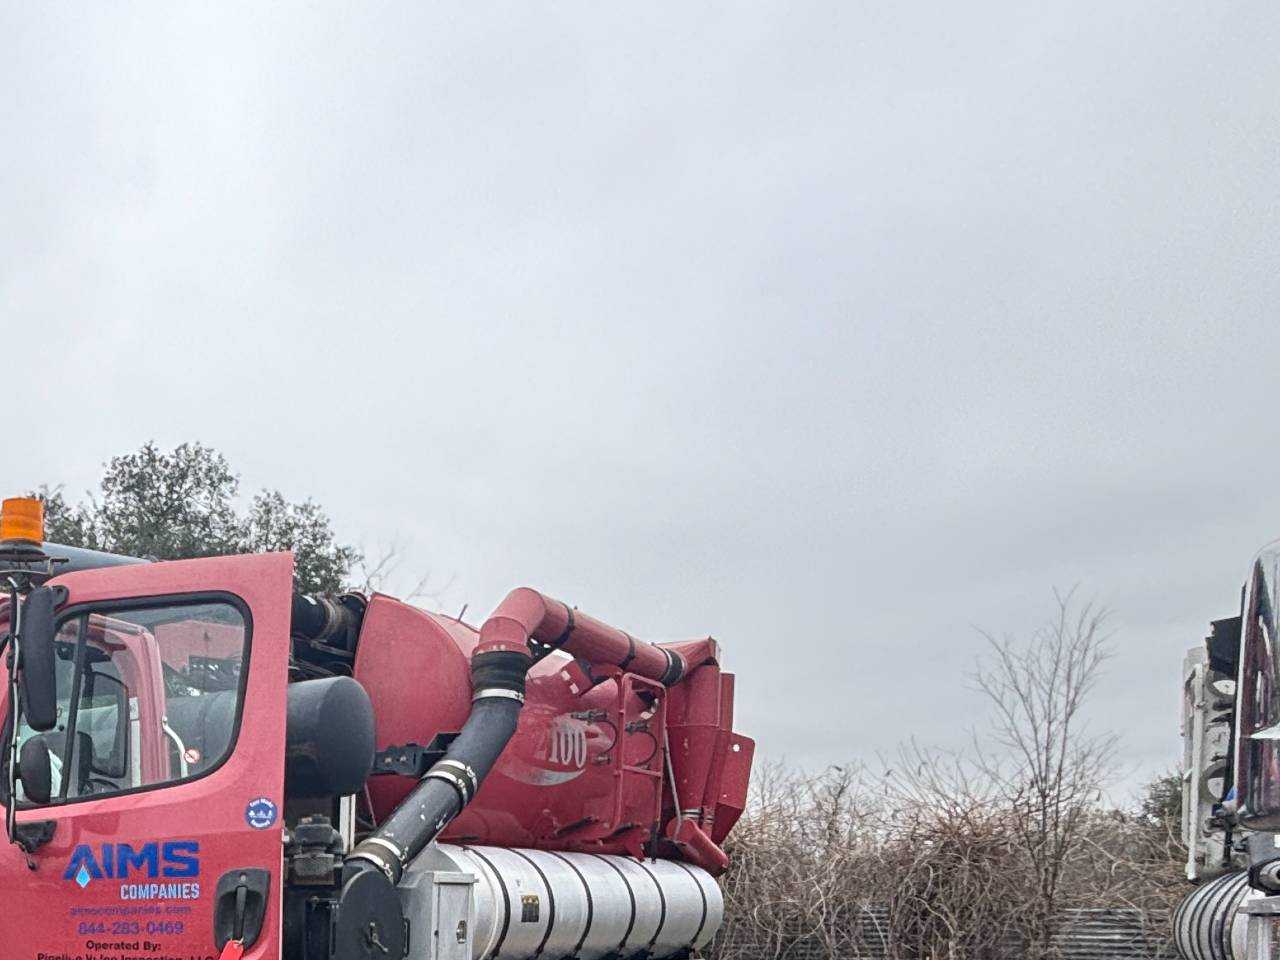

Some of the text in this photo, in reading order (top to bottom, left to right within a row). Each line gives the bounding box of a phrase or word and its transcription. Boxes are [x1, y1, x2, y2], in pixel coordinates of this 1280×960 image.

[63, 841, 200, 880] AIMS
[120, 883, 200, 900] COMPANIES
[86, 940, 161, 951] Operated By:
